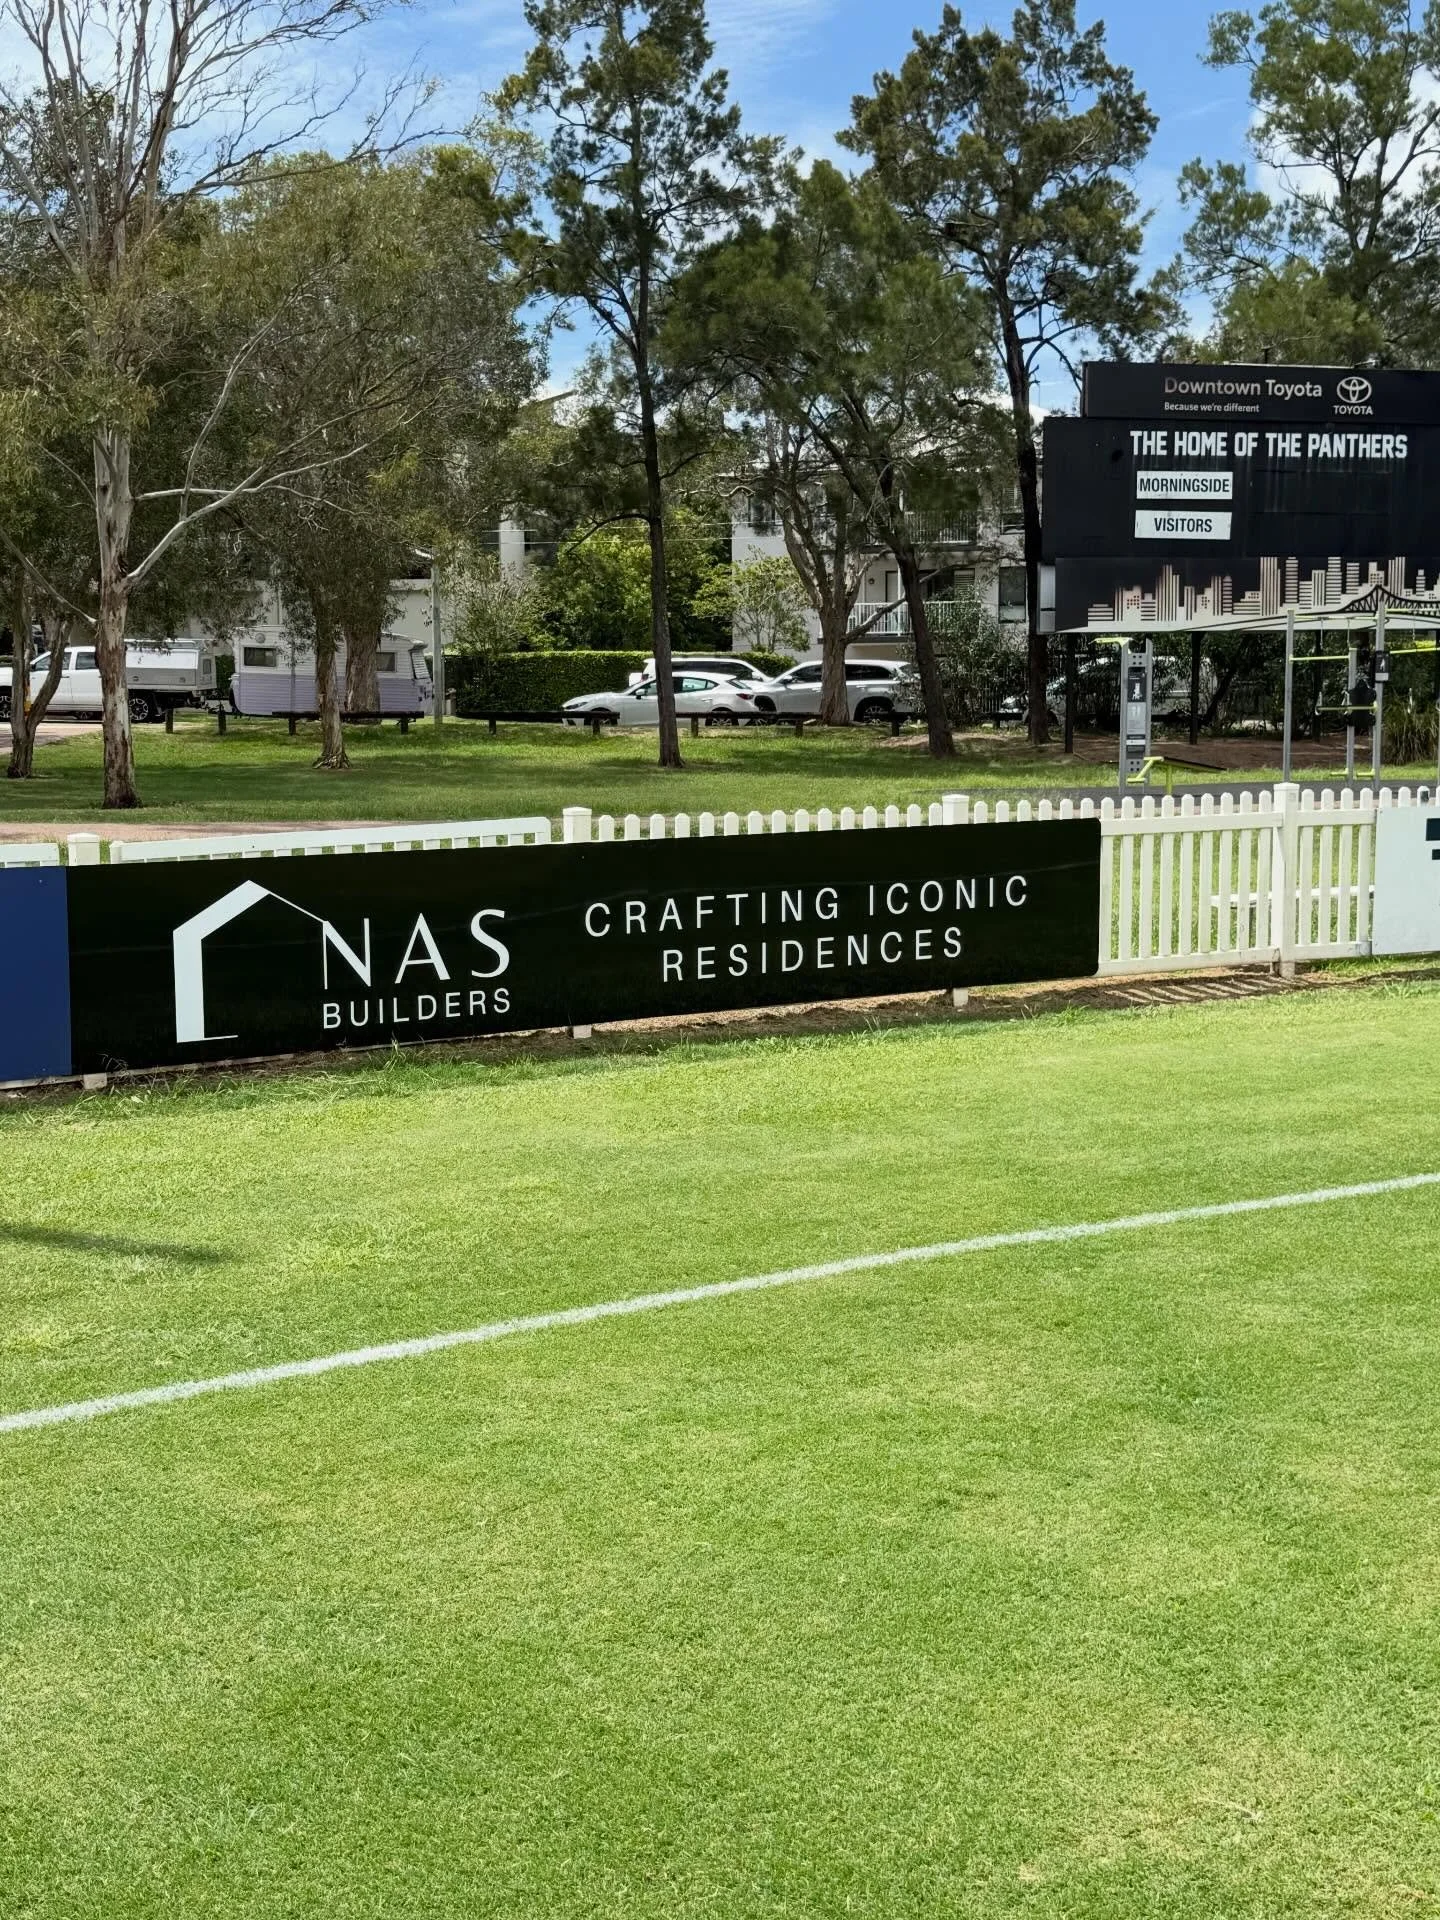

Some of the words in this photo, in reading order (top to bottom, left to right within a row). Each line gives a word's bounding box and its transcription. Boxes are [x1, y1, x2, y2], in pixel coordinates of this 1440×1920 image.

[1164, 376, 1261, 396] Downtown
[1266, 379, 1323, 400] Toyota
[1164, 401, 1199, 412] Because
[1200, 402, 1222, 412] we're
[1223, 402, 1260, 413] different
[1333, 404, 1374, 416] TOYOTA
[1130, 430, 1168, 456] THE
[1174, 431, 1228, 457] HOME
[1235, 431, 1259, 457] OF
[1265, 432, 1302, 458] THE
[1307, 433, 1408, 459] PANTHERS
[1139, 477, 1231, 494] MORNINGSIDE
[1153, 517, 1213, 534] VISITORS
[584, 886, 840, 938] CRAFTING
[868, 874, 1029, 917] ICONIC
[322, 908, 511, 990] NAS
[662, 926, 964, 984] RESIDENCES
[322, 987, 512, 1030] BUILDERS
